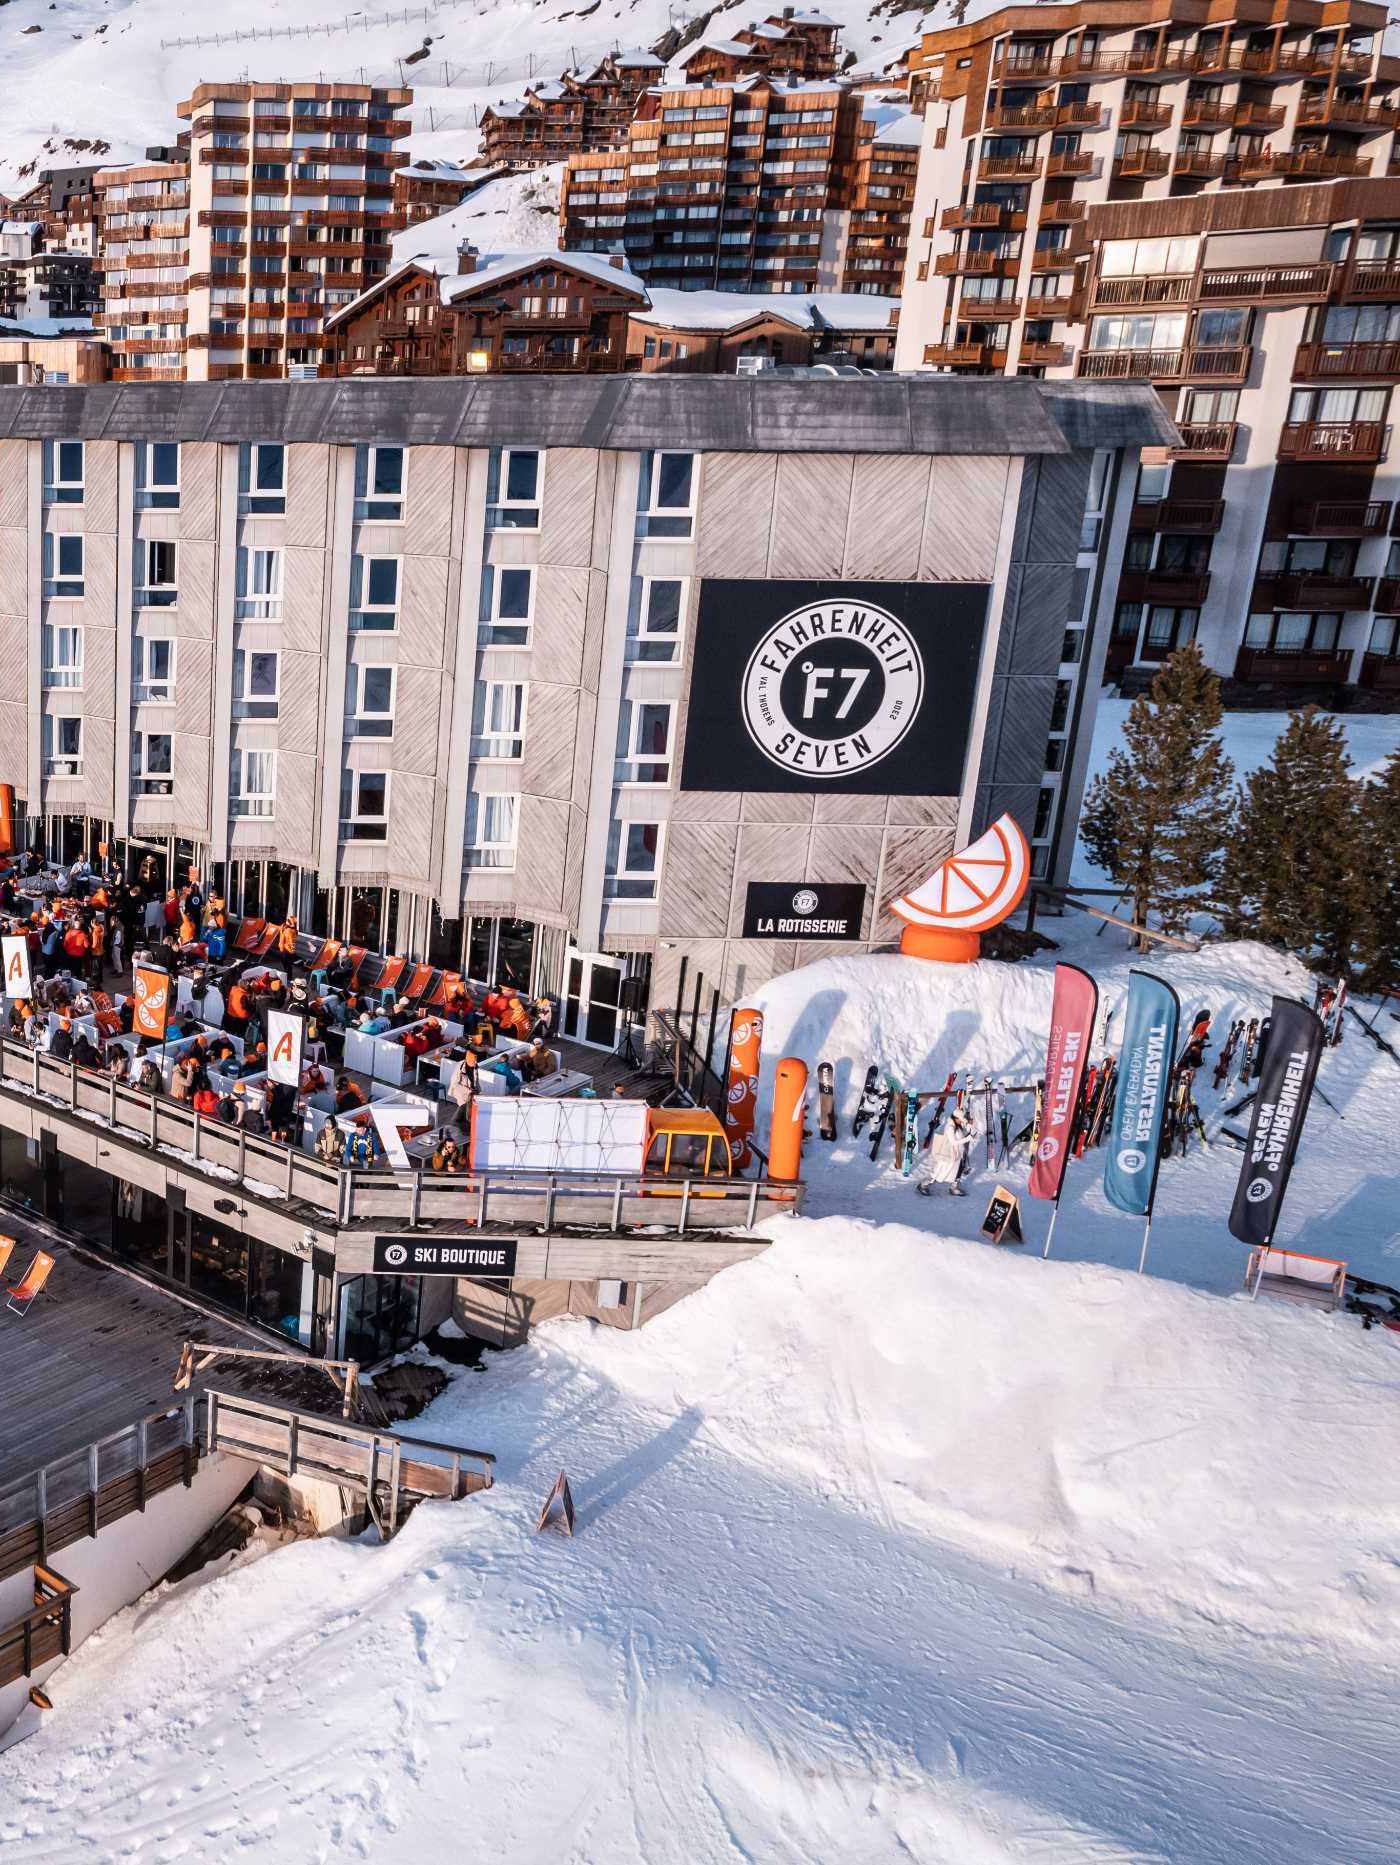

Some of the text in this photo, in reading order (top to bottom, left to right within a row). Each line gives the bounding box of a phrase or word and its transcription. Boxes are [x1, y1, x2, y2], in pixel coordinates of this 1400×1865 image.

[761, 609, 913, 674] FAHRENHEIT
[758, 676, 776, 727] VAL THORENS
[889, 700, 903, 720] 2300
[774, 733, 872, 767] SEVEN
[757, 918, 848, 934] LA ROTISSERIE
[273, 1031, 293, 1062] A
[414, 1248, 506, 1265] SKI BOUTIQUE
